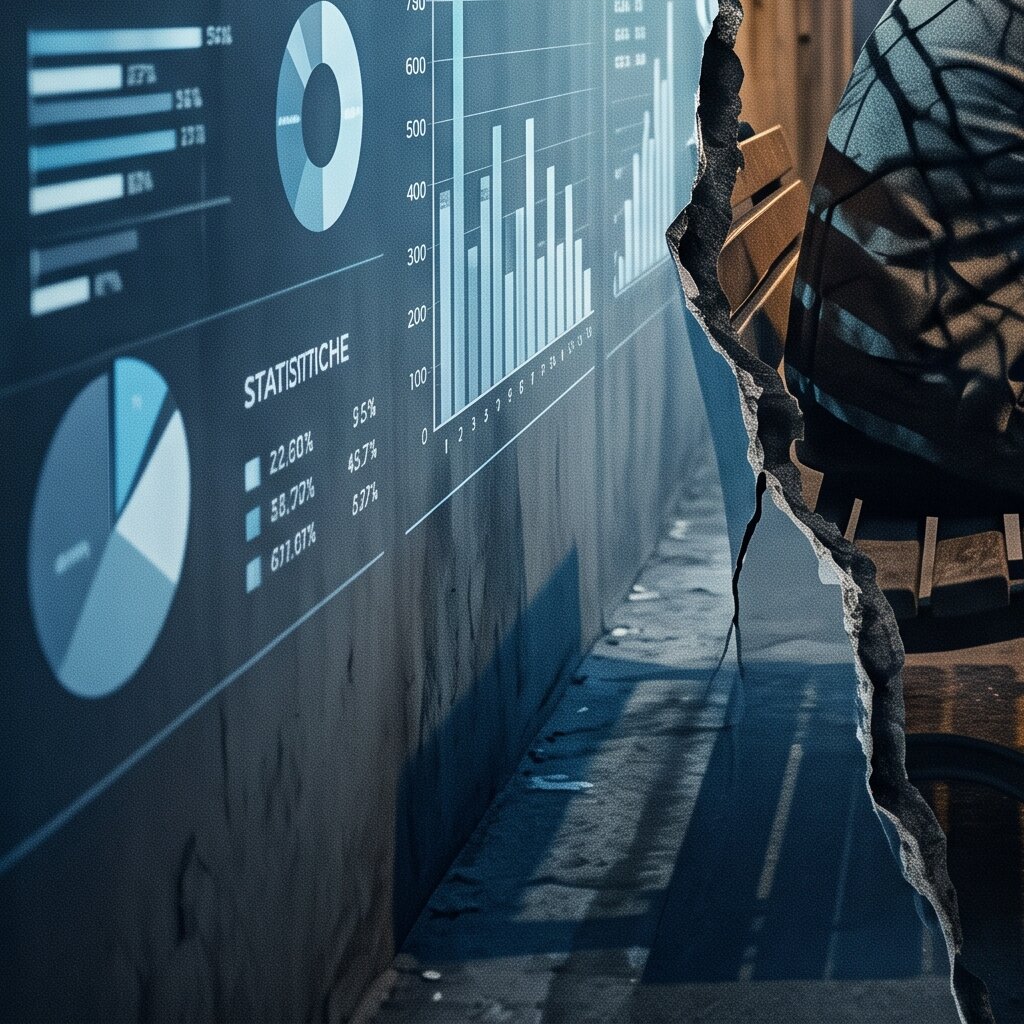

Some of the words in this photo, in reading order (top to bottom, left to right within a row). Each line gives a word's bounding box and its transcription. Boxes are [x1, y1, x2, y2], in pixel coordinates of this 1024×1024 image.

[405, 56, 427, 76] 600
[406, 118, 427, 139] 500
[406, 181, 427, 202] 400
[407, 243, 427, 266] 300
[407, 305, 428, 329] 200
[408, 366, 428, 391] 100
[421, 427, 429, 446] 0
[458, 426, 465, 443] 2
[269, 430, 314, 475] 22.60%
